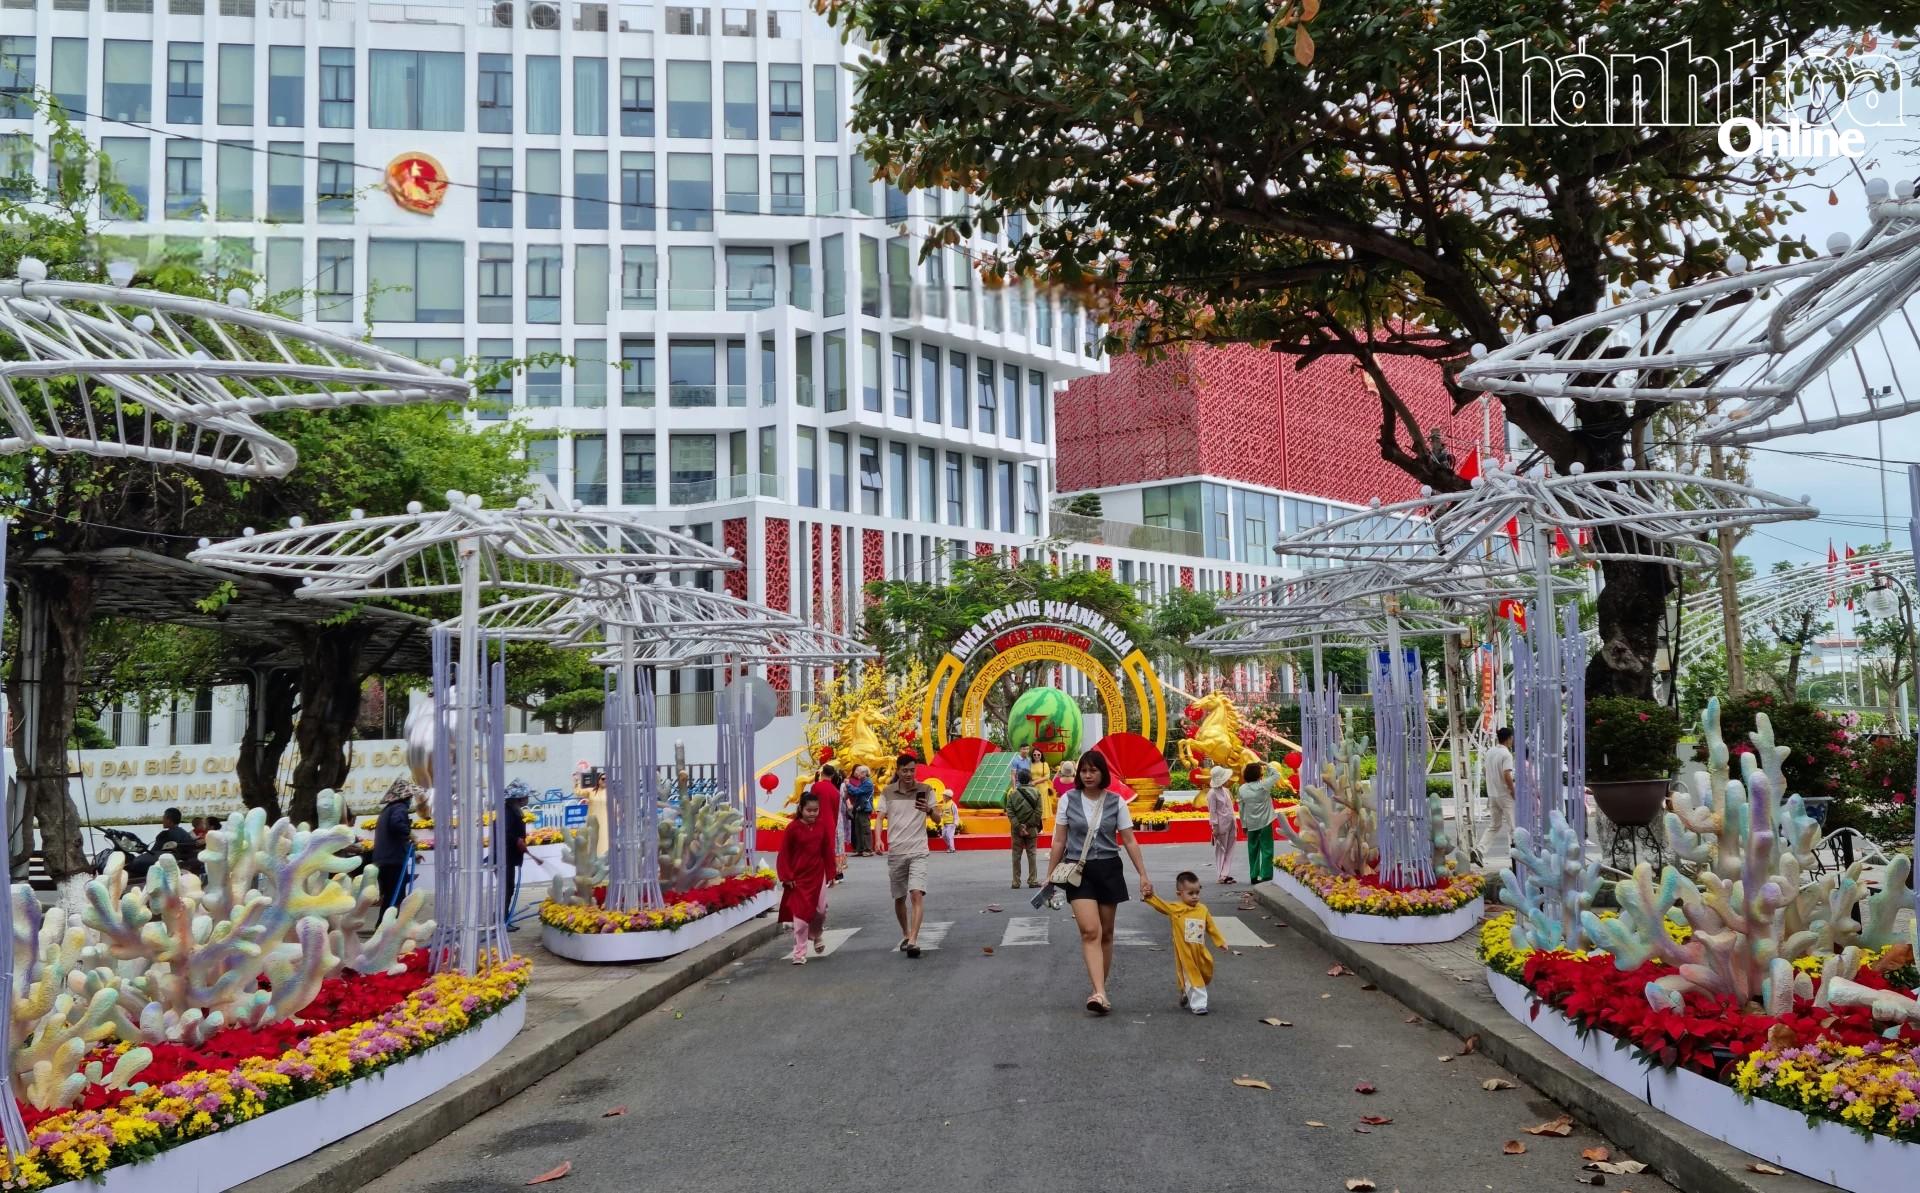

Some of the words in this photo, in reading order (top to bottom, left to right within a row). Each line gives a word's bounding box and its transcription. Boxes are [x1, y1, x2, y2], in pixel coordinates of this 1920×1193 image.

[951, 623, 988, 659] NHA
[981, 599, 1041, 630] TRANG
[1043, 599, 1105, 632] KHÁNH
[1100, 622, 1135, 656] HÒA
[101, 759, 138, 780] ĐẠI
[144, 751, 196, 776] BIỂU
[504, 744, 546, 763] DÂN
[96, 782, 127, 803] ỦY
[133, 785, 178, 802] BAN
